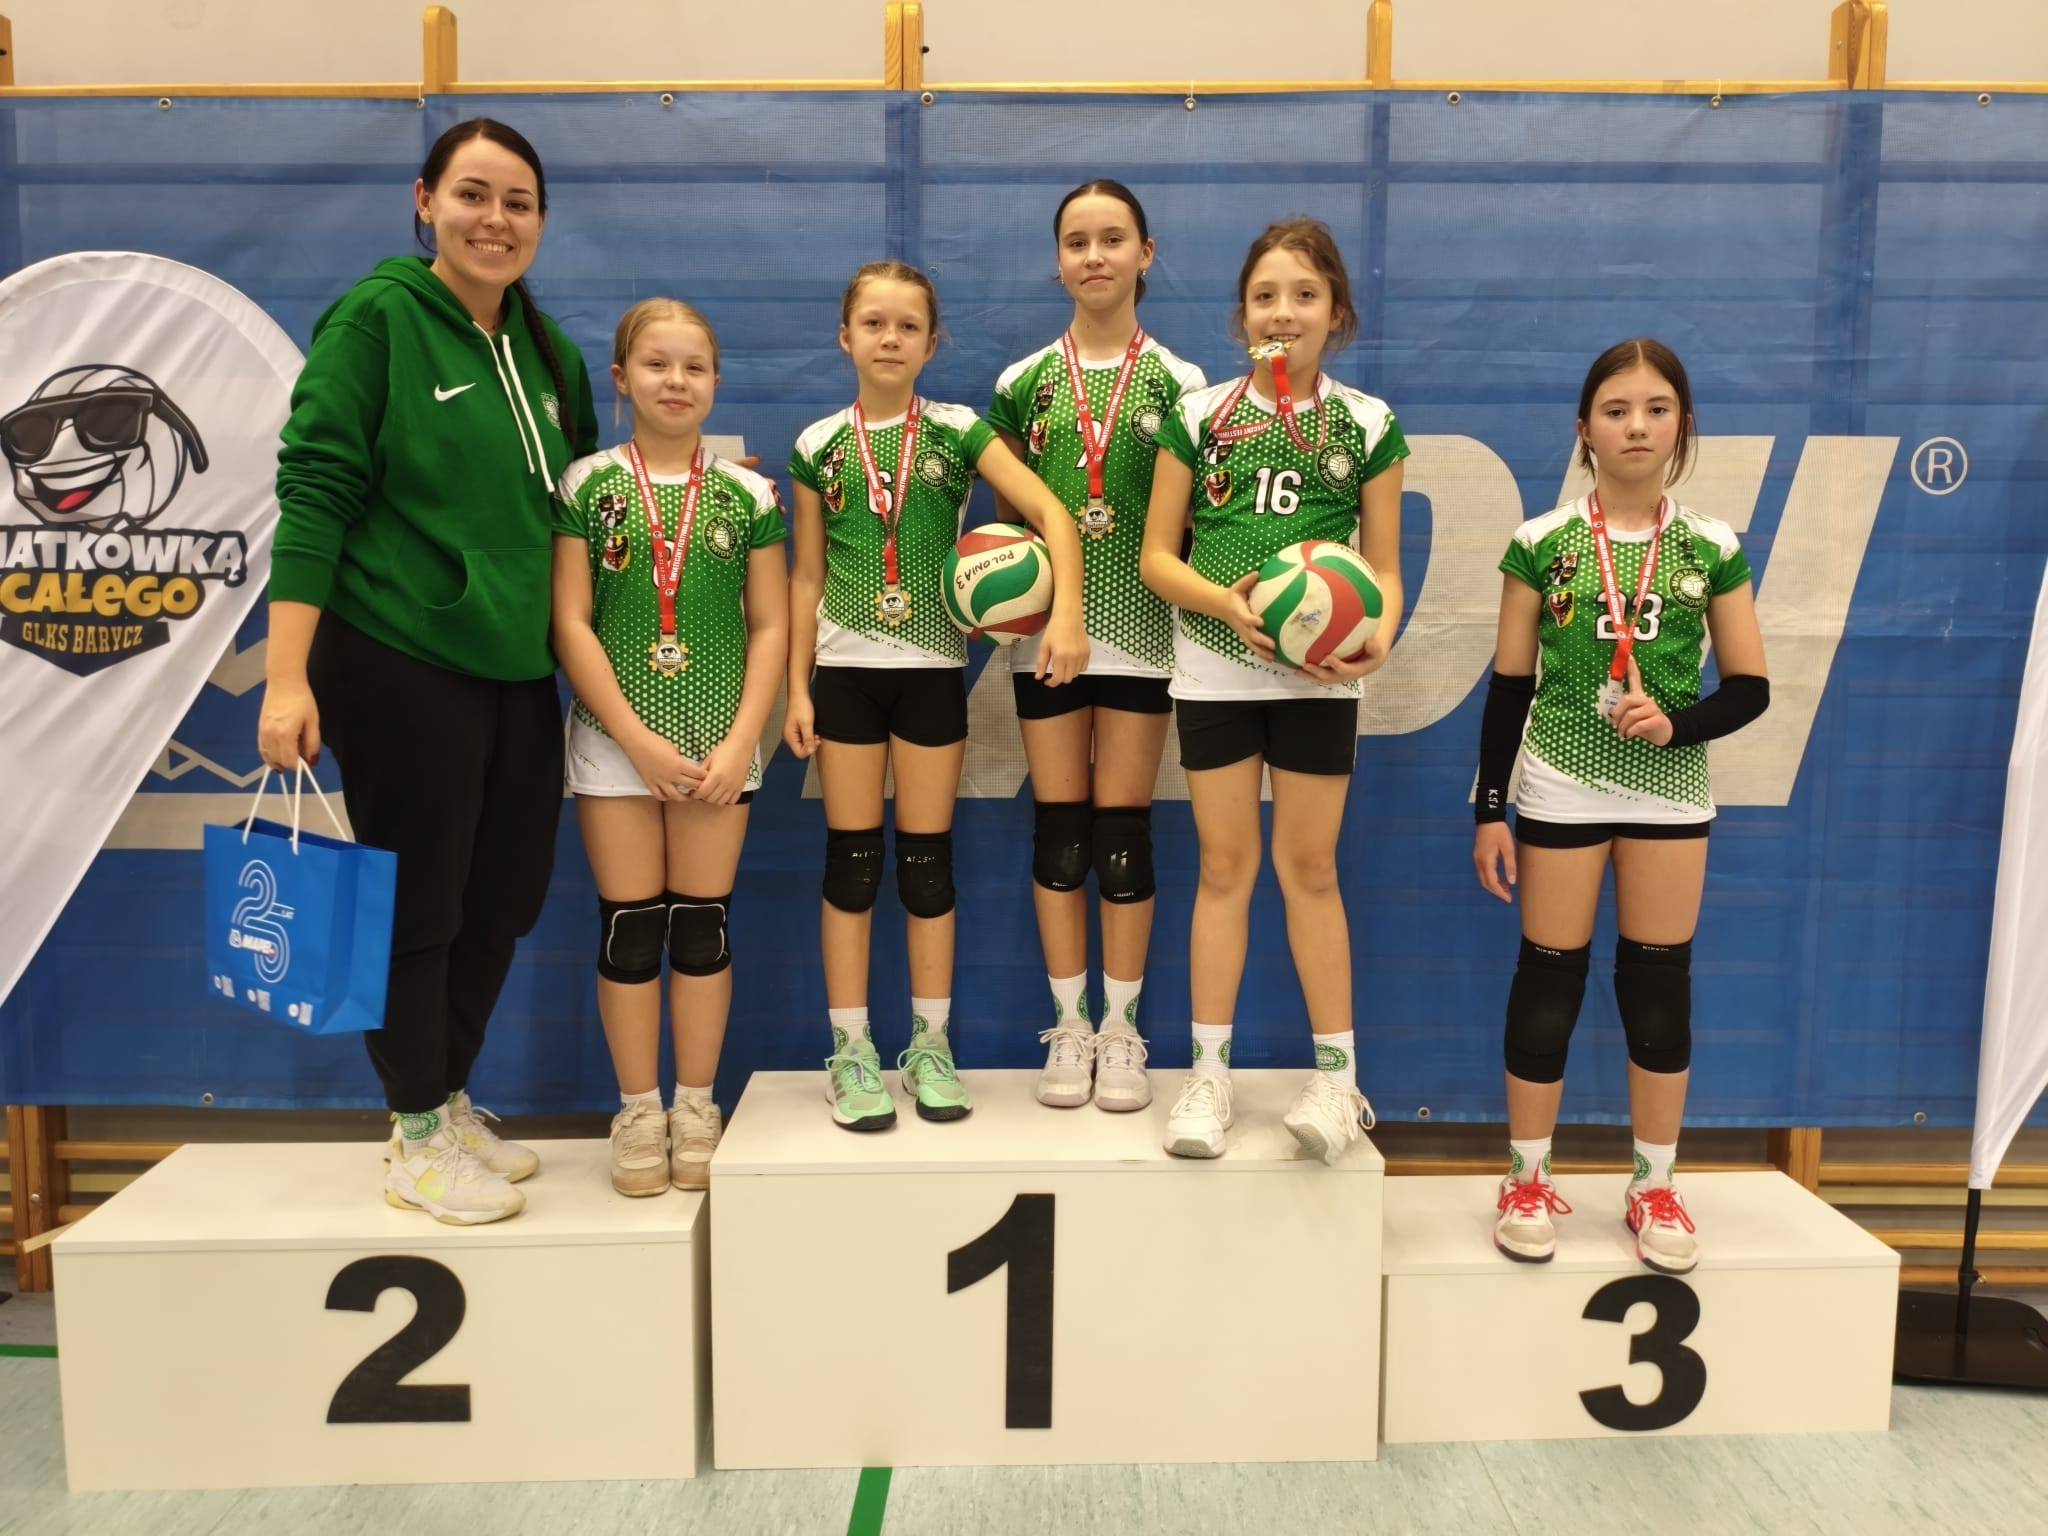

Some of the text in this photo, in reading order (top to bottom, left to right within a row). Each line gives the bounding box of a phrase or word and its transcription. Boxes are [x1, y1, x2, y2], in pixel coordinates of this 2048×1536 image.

[1133, 407, 1145, 422] MKS
[1319, 449, 1332, 464] MKS
[868, 470, 895, 515] 6
[1254, 466, 1303, 516] 16
[965, 549, 1015, 582] POLONIA
[22, 621, 144, 654] GLKS BARYCZ
[1595, 591, 1664, 641] 23
[948, 1194, 1055, 1428] 1
[326, 1256, 470, 1423] 2
[1580, 1274, 1706, 1431] 3
